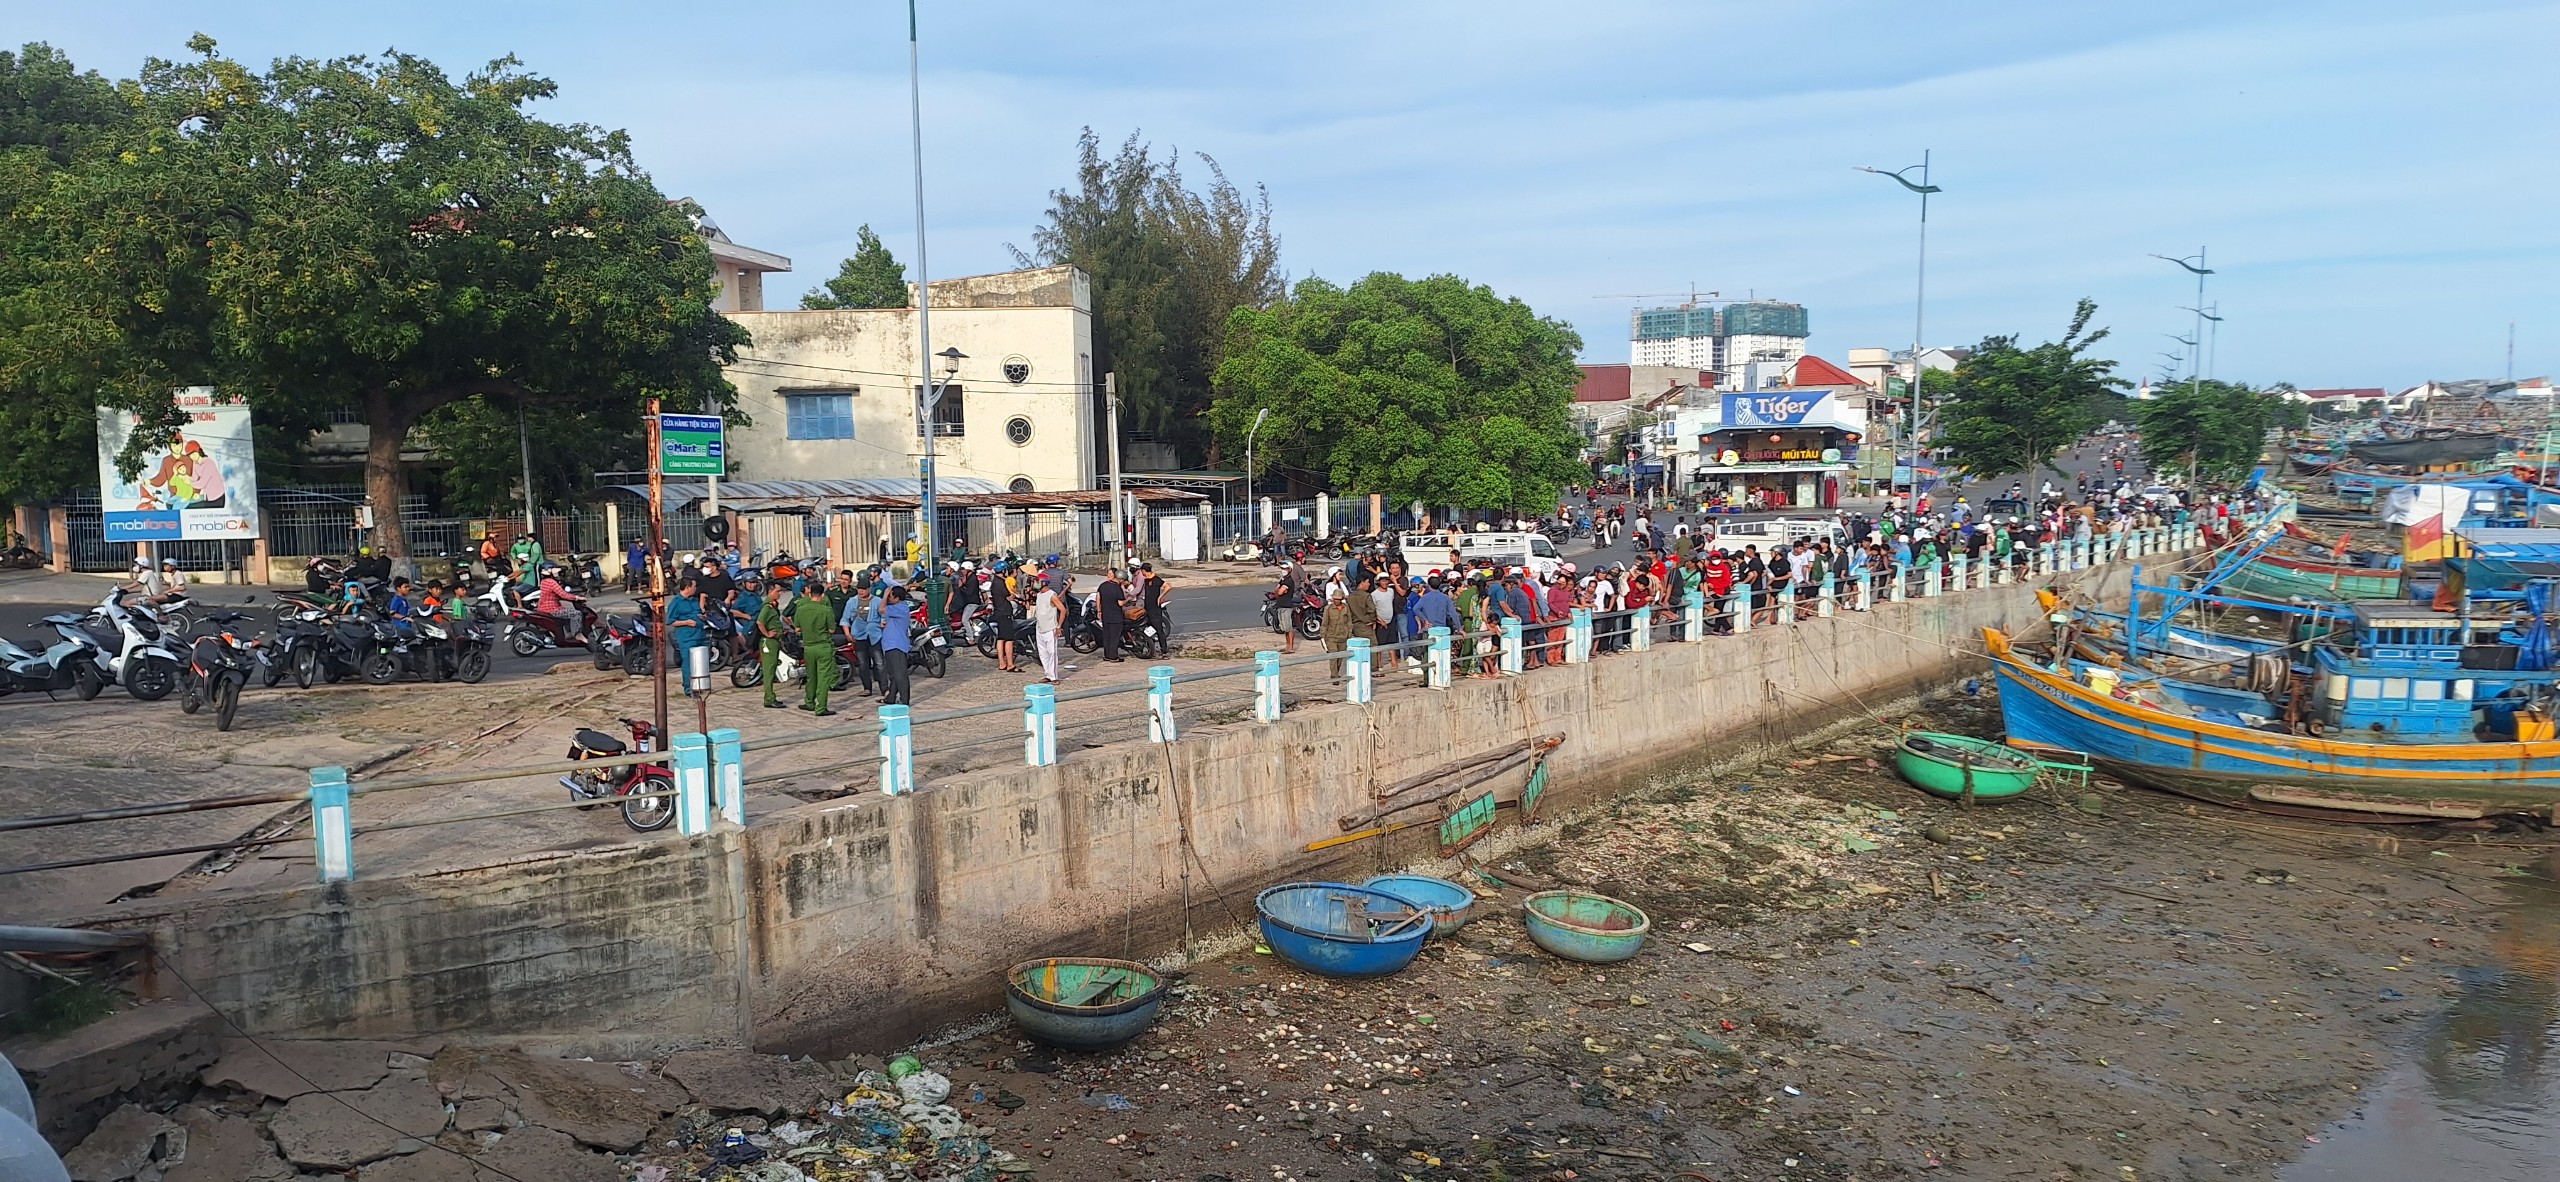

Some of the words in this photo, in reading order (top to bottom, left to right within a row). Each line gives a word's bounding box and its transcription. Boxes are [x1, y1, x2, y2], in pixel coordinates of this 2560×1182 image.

[1756, 396, 1809, 421] Tiger
[674, 419, 688, 427] HÀNG
[1781, 448, 1799, 459] MŨI
[1800, 447, 1819, 459] TÀU
[110, 518, 178, 531] mobifone
